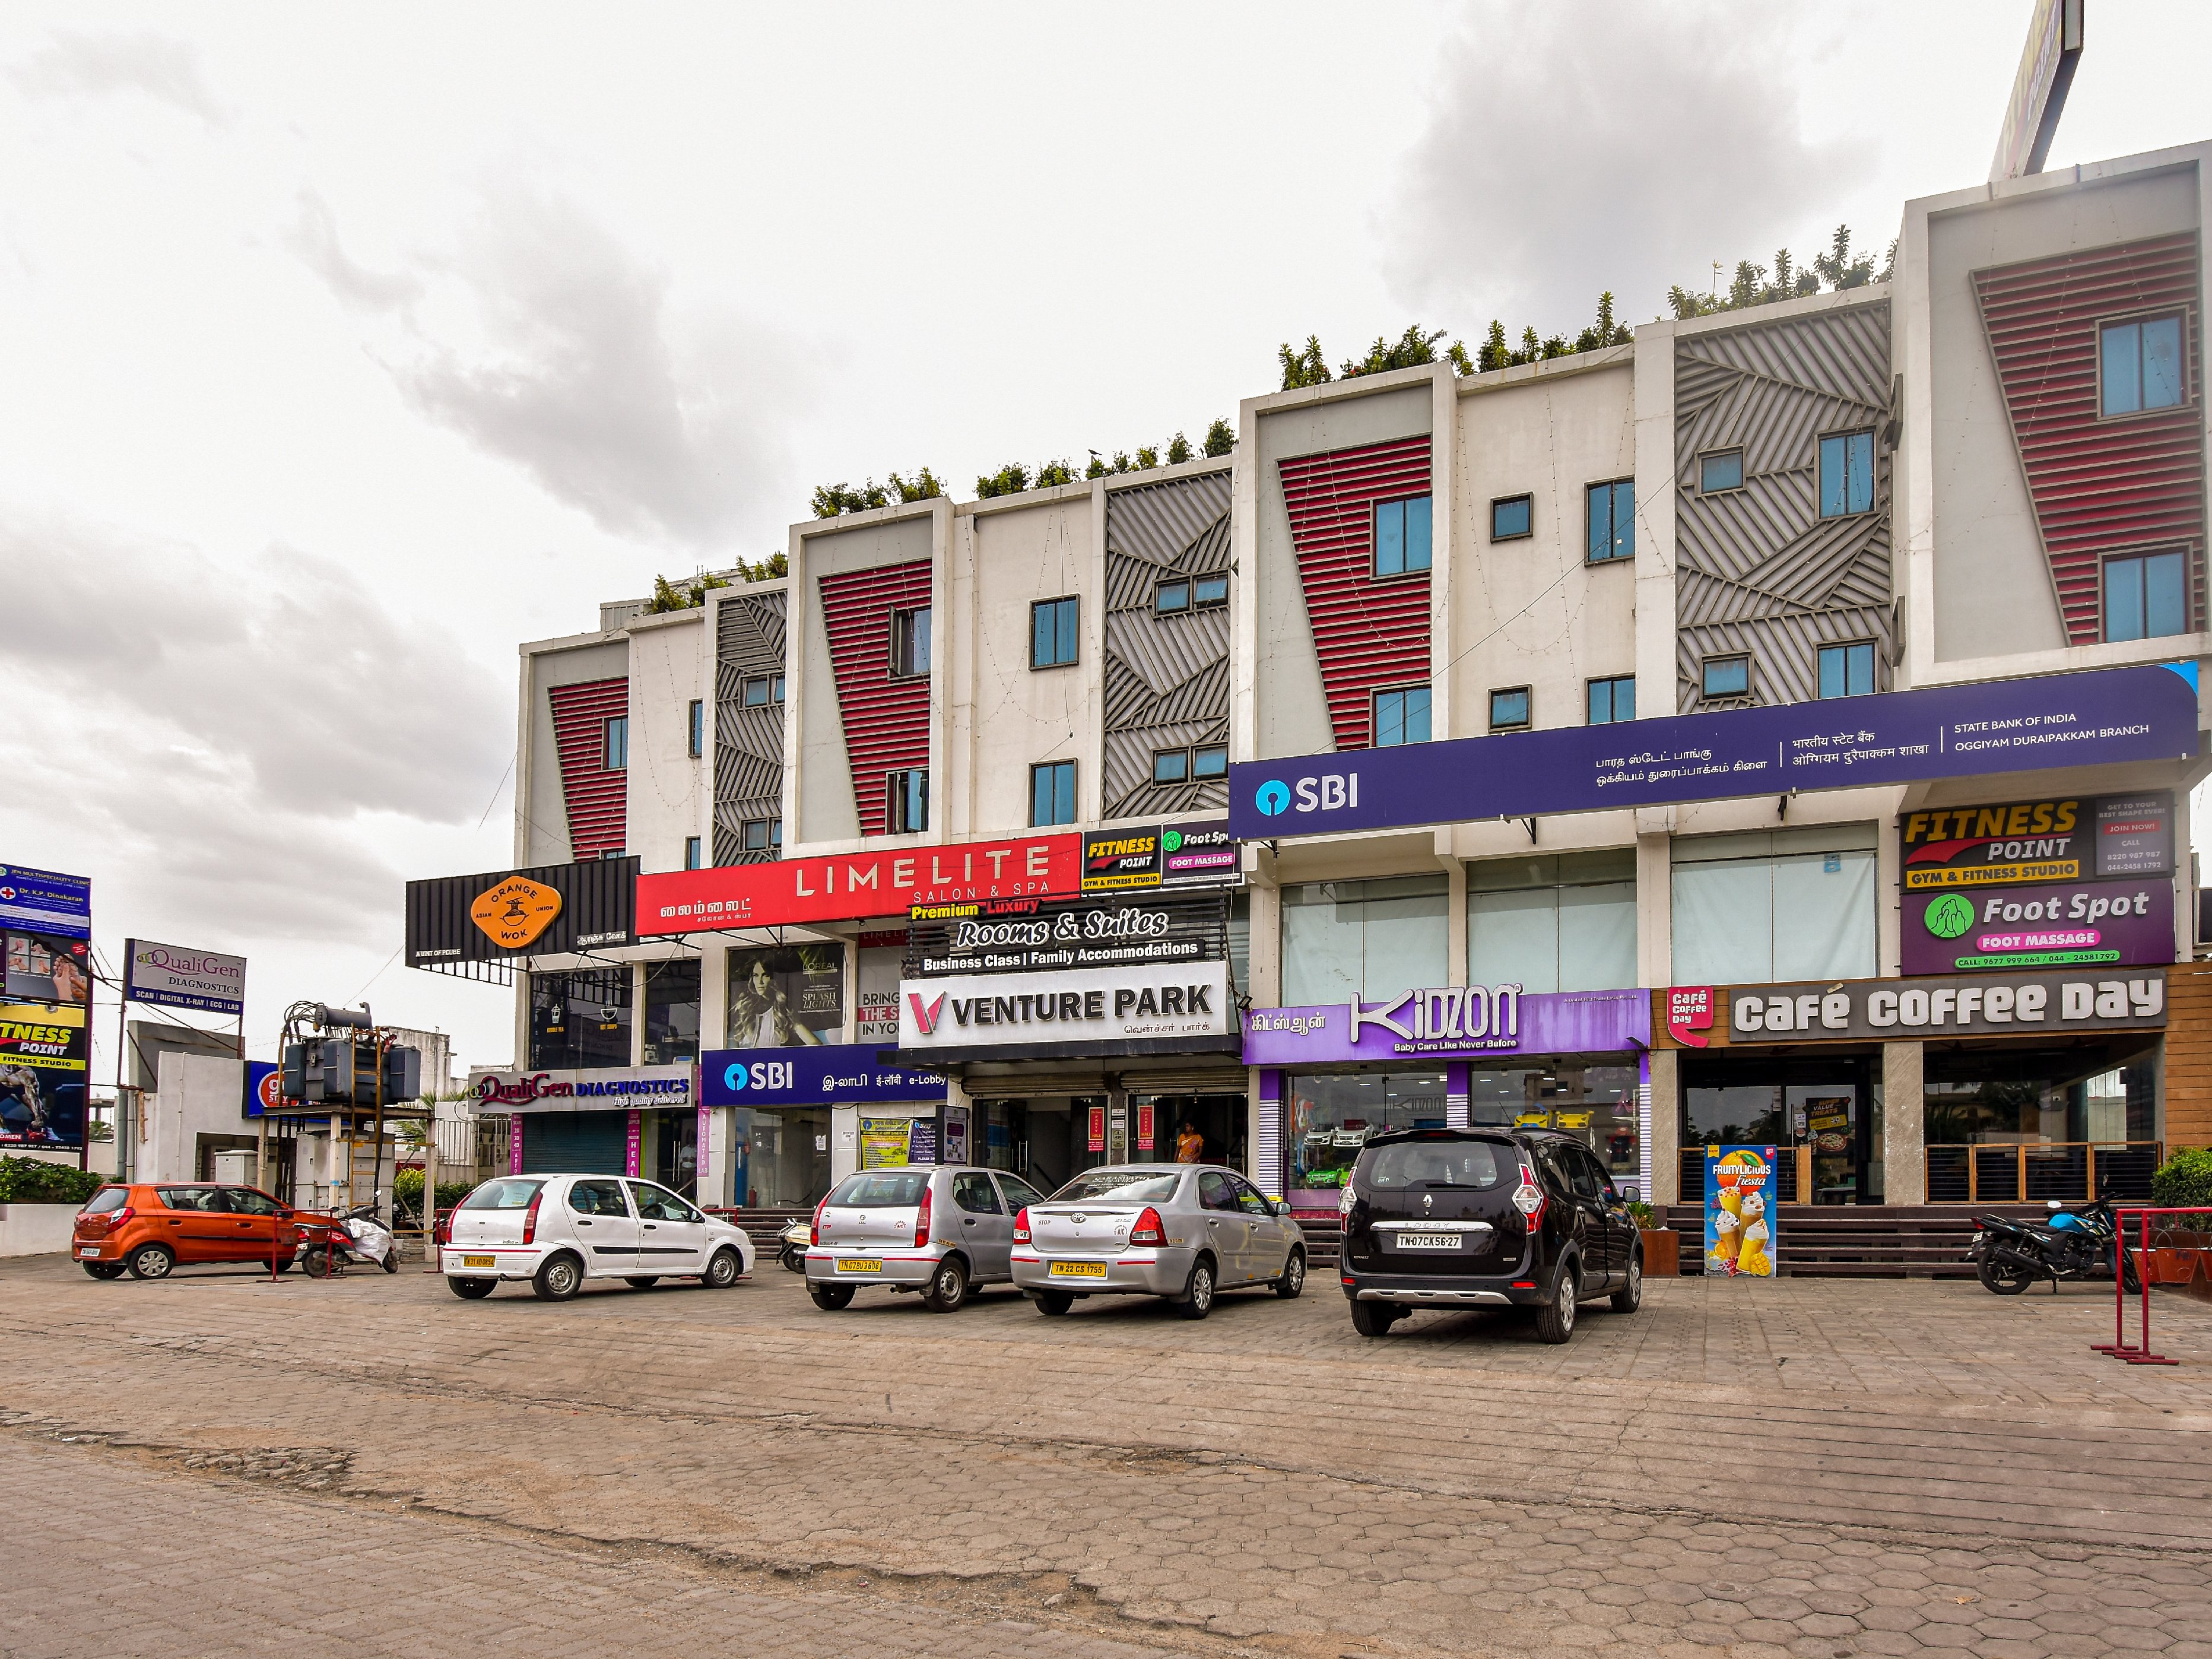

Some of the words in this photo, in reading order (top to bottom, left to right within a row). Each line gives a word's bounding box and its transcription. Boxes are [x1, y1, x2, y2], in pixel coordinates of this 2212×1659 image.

[1954, 721, 1989, 734] STATE
[1992, 718, 2023, 730] BANK
[2025, 716, 2041, 727] OF
[2044, 713, 2077, 725] INDIA
[1792, 735, 1829, 749] भारतीय
[1832, 732, 1854, 746] स्टेट
[1857, 730, 1875, 743] बैंक
[1955, 738, 2009, 751] OGGIYAM
[2013, 729, 2096, 746] DURAIPAKKAM
[2100, 724, 2150, 738] BRANCH
[1595, 757, 1625, 769] பாரத
[1629, 751, 1671, 765] ஸ்டேட்
[1674, 748, 1712, 760] பாங்கு
[1899, 744, 1929, 756] शाखा
[1597, 770, 1644, 787] ஒக்கியம்
[1648, 762, 1729, 783] துரைப்பாக்கம்
[1733, 760, 1768, 772] கிளை
[1295, 772, 1358, 813] SBI
[1905, 801, 2078, 843] FITNESS
[1088, 836, 1156, 858] FITNESS
[1183, 832, 1211, 845] Foot
[1988, 838, 2071, 861] POINT
[1119, 856, 1153, 869] POINT
[1172, 858, 1193, 867] FOOT
[1195, 855, 1233, 865] MASSAGE
[2108, 862, 2141, 871] 044-2458
[23, 871, 71, 882] MULTISPECIALITY
[796, 845, 1049, 897] LIMELITE
[1911, 873, 1943, 884] GYM
[1947, 871, 1958, 883] &
[1963, 867, 2017, 881] FITNESS
[2021, 863, 2075, 877] STUDIO
[1107, 877, 1132, 885] FITNESS
[1134, 876, 1157, 884] STUDIO
[47, 892, 84, 902] Dinakaran
[491, 884, 538, 903] ORANGE
[913, 887, 976, 903] SALON
[990, 885, 999, 897] &
[1013, 881, 1049, 895] SPA
[660, 897, 751, 918] லைம்லைட்
[912, 903, 979, 920] Premium
[986, 899, 1040, 913] Luxury
[1983, 897, 2062, 923] Foot
[2068, 891, 2150, 924] Spot
[501, 929, 528, 940] WOK
[957, 921, 1050, 948] Rooms
[1053, 913, 1081, 940] &
[1086, 908, 1170, 938] Suites
[1982, 935, 2021, 949] FOOT
[2025, 932, 2095, 947] MASSAGE
[145, 949, 240, 978] QualiGen
[923, 954, 982, 972] Business
[984, 953, 1021, 968] Class
[1031, 949, 1074, 966] Family
[1077, 942, 1198, 961] Accommodations
[2073, 953, 2115, 961] 24581792
[169, 976, 240, 994] DIAGNOSTICS
[136, 991, 154, 1000] SCAN
[160, 994, 185, 1004] DIGITAL
[186, 997, 205, 1006] X-RAY
[210, 1001, 223, 1009] ECG
[802, 992, 836, 1001] SPLASH
[804, 1000, 837, 1008] LIGHTS
[863, 992, 900, 1005] BRING
[951, 990, 1105, 1026] VENTURE
[1114, 984, 1213, 1017] PARK
[863, 1007, 887, 1021] THE
[890, 1006, 900, 1020] S
[0, 1022, 72, 1044] TNESS
[862, 1023, 875, 1036] IN
[878, 1022, 900, 1035] YO
[1124, 1023, 1175, 1034] வென்ச்சர்
[1182, 1021, 1210, 1032] பார்க்
[19, 1042, 67, 1055] POINT
[1394, 1043, 1416, 1052] Baby
[1487, 1039, 1516, 1048] Before
[750, 1061, 793, 1090] SBI
[876, 1074, 902, 1087] ई-लॉबी
[909, 1074, 946, 1086] e-Lobby
[478, 1073, 574, 1106] QualiGen
[576, 1078, 689, 1097] DIAGNOSTICS
[612, 1096, 630, 1107] High
[630, 1096, 653, 1106] quality
[653, 1094, 688, 1104] delivered
[1810, 1108, 1839, 1116] TREATS
[1713, 1165, 1771, 1175] FRUITYLICIOUS
[1087, 1265, 1102, 1274] 1755
